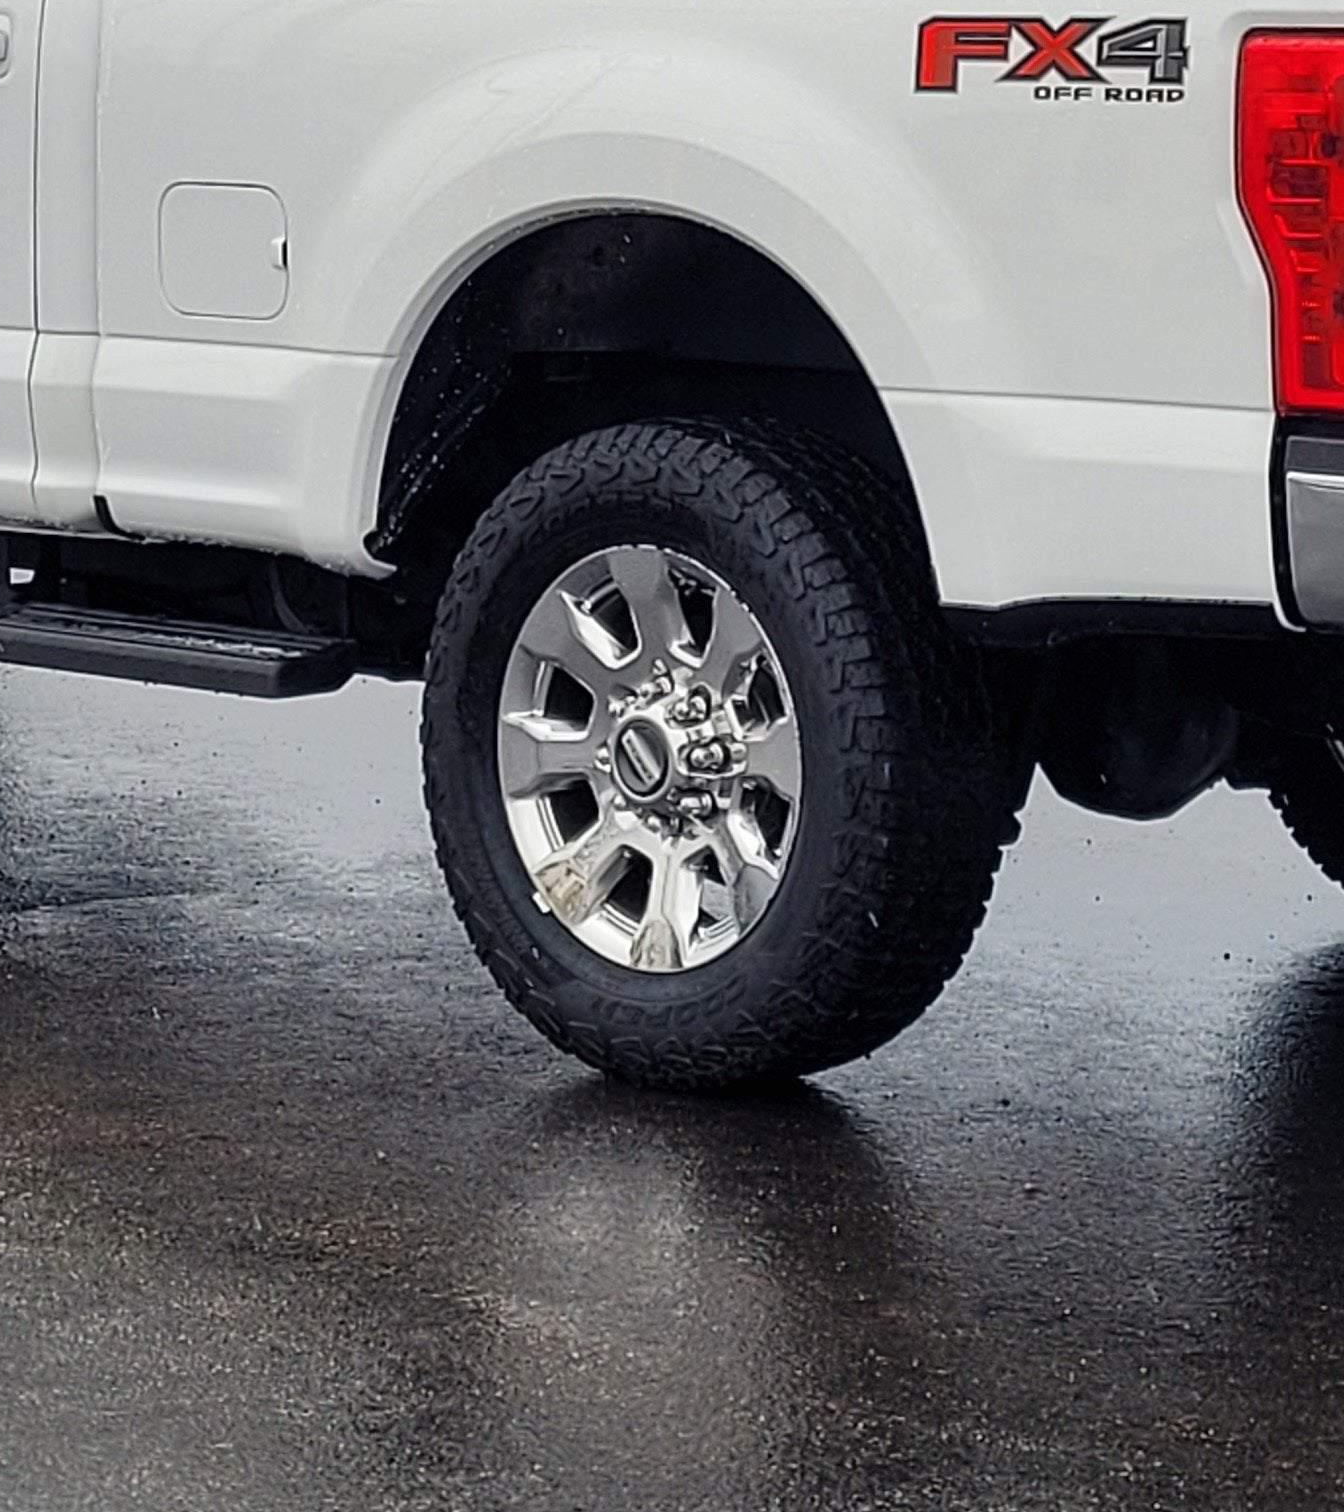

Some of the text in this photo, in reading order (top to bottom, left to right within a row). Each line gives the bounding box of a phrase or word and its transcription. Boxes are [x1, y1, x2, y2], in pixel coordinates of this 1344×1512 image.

[915, 16, 1190, 92] FX4
[1033, 85, 1185, 102] OFF ROAD
